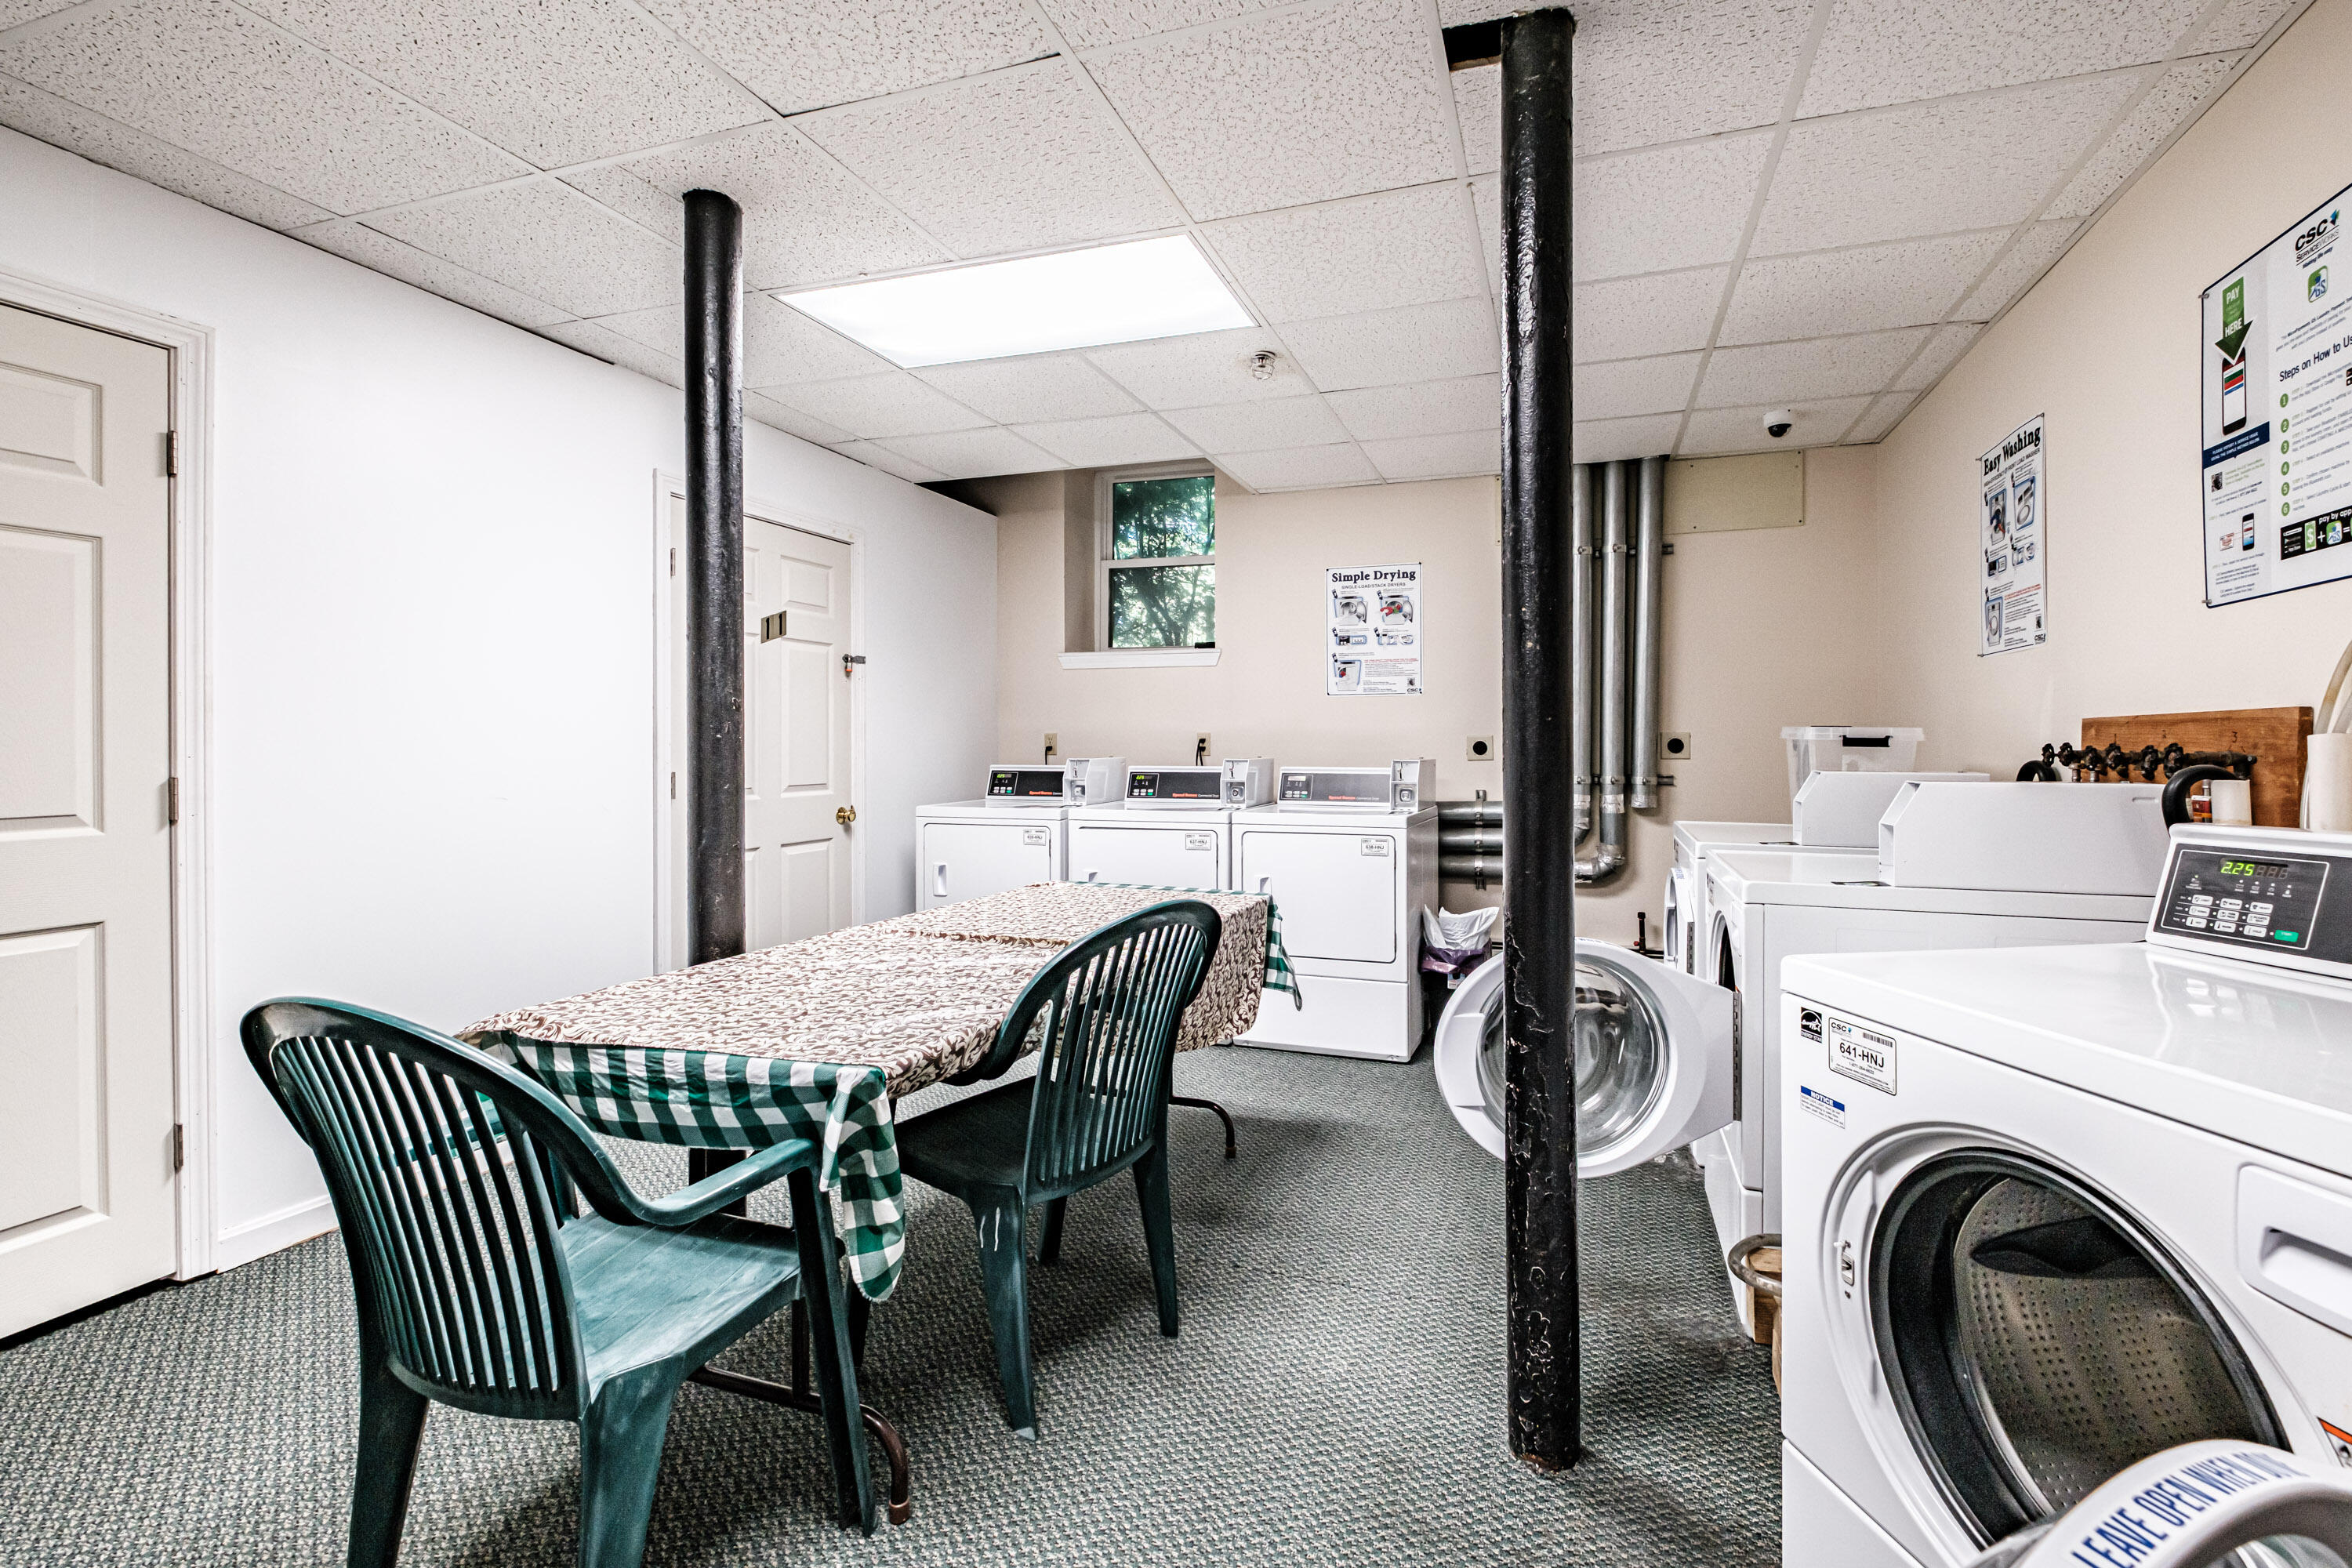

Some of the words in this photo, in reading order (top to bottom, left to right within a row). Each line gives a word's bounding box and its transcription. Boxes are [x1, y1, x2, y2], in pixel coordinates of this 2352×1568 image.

[2295, 218, 2328, 252] CSC
[2226, 285, 2240, 304] PAY
[2225, 318, 2242, 338] HERE
[2279, 365, 2299, 382] Steps
[2301, 359, 2311, 370] on
[2314, 348, 2331, 364] How
[2333, 343, 2341, 354] to
[1984, 453, 2002, 476] Easy
[2002, 426, 2041, 462] Washing
[2283, 504, 2288, 513] 6
[2319, 515, 2330, 524] pay
[2340, 509, 2352, 517] app
[1331, 571, 1370, 584] Simple
[1374, 569, 1417, 582] Drying
[2231, 731, 2238, 742] 3
[2220, 862, 2255, 876] 2.25
[1831, 1022, 1847, 1033] CSC
[1839, 1042, 1885, 1068] 641-HNJ
[1810, 1091, 1834, 1106] NOTICE
[2132, 1474, 2220, 1528] OPEN
[2179, 1455, 2270, 1495] WHEN
